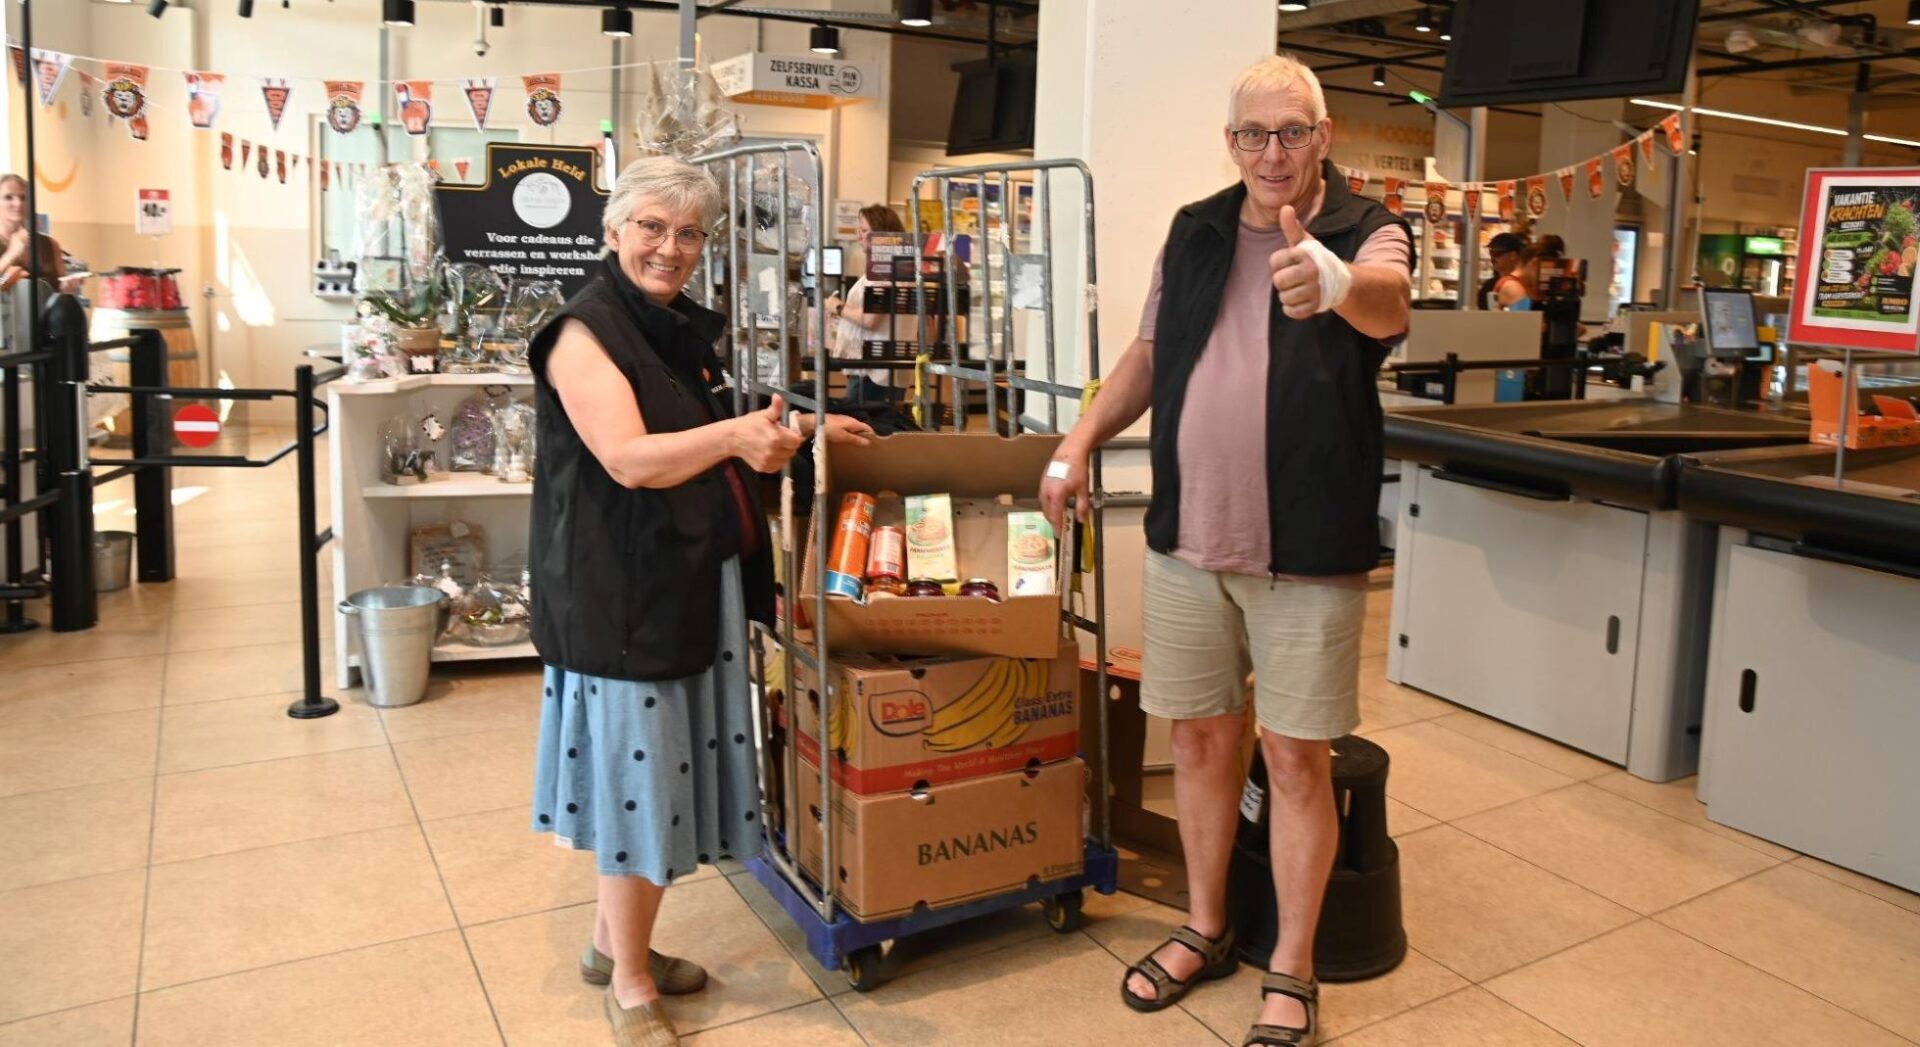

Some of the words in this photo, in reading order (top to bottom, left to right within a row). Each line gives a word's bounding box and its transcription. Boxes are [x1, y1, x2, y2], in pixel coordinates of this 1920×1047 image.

[770, 60, 835, 76] ZELFSERVICE
[786, 75, 819, 89] KASSA
[498, 156, 548, 178] Lokale
[551, 158, 586, 181] Held
[1834, 191, 1875, 206] VAKANTIE
[1828, 203, 1884, 222] KRACHTEN
[486, 232, 519, 243] Voor
[520, 233, 573, 245] cadeaus
[575, 234, 596, 245] die
[464, 249, 528, 259] verrassen
[529, 250, 547, 259] en
[549, 250, 604, 261] worksho
[520, 263, 585, 277] inspireren
[882, 700, 925, 719] Dole
[1014, 701, 1072, 724] BANANAS
[918, 821, 1038, 865] BANANAS
